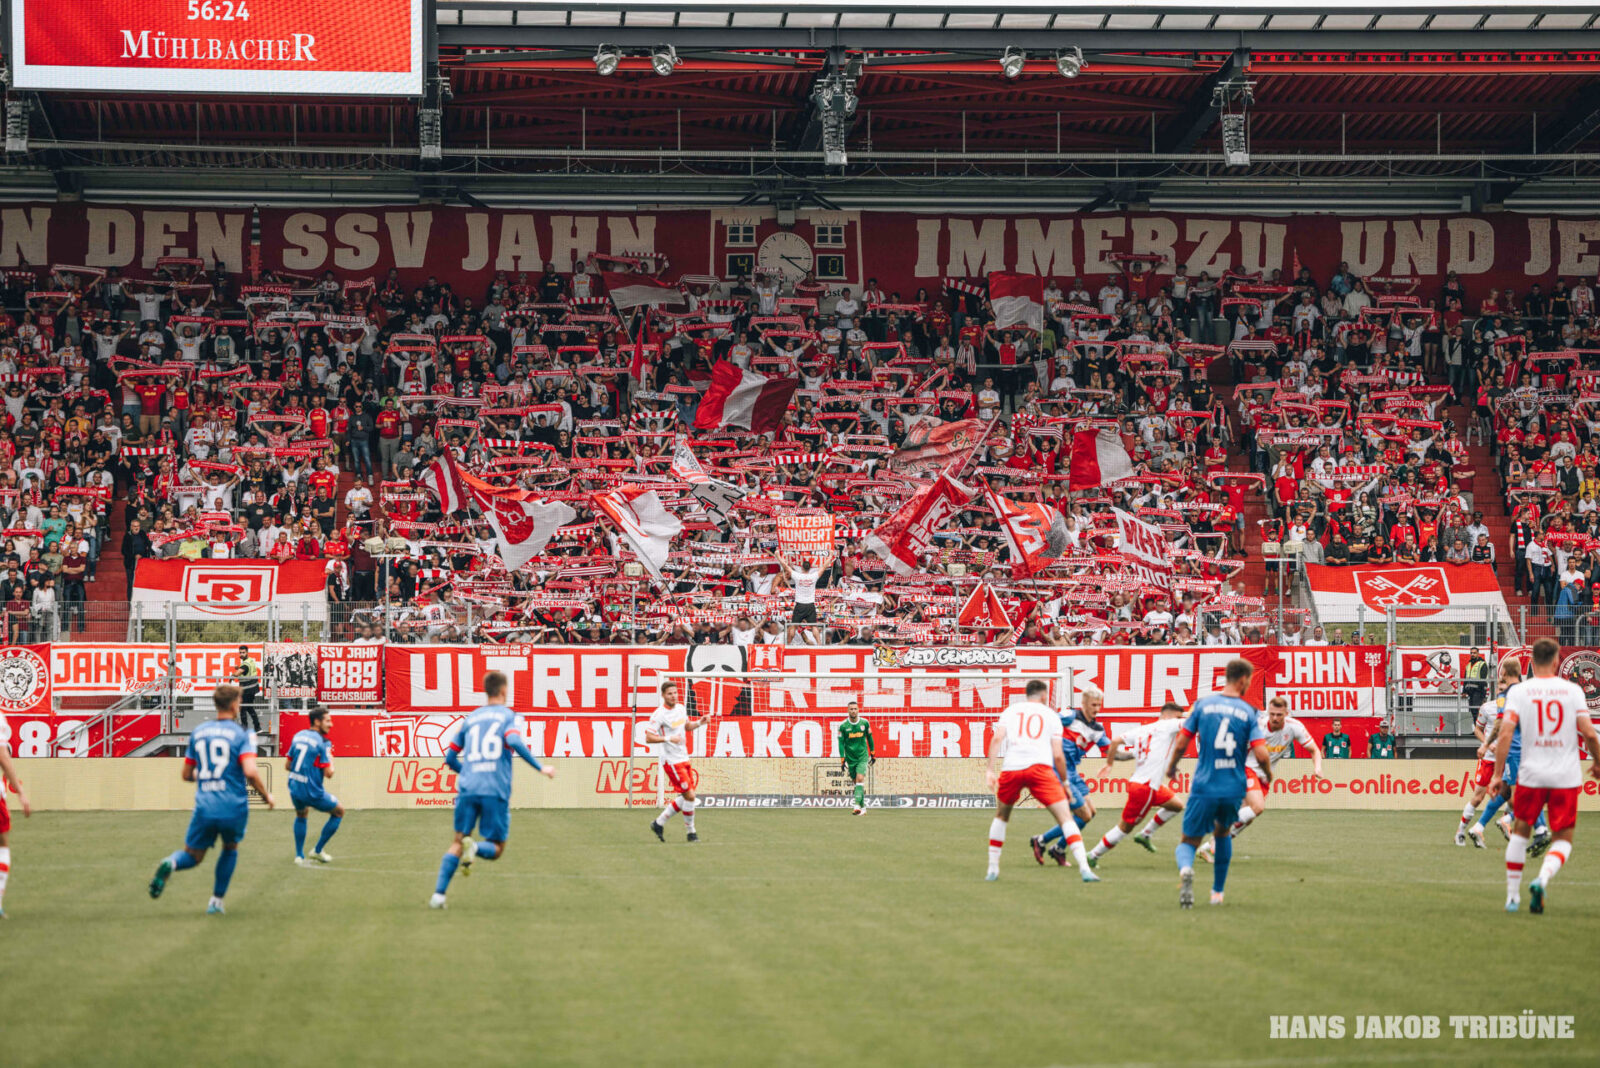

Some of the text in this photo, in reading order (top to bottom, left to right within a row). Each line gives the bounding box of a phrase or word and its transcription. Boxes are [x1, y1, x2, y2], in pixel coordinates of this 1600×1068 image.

[187, 0, 249, 21] 56:24
[120, 29, 317, 62] MÜHLBACHER
[86, 209, 245, 273] DEN
[283, 211, 433, 271] SSV
[462, 212, 657, 275] JAHN
[915, 217, 1286, 279] IMMERZU
[1341, 217, 1495, 276] UND
[777, 515, 834, 527] ACHTZEHN
[779, 528, 832, 541] HUNDERT
[321, 646, 343, 658] SSV
[346, 646, 378, 658] JAHN
[902, 648, 936, 667] RED
[321, 660, 377, 689] 1889
[410, 653, 669, 708] ULTRAS
[1276, 651, 1356, 684] JAHN
[321, 691, 378, 701] REGENSBURG
[1016, 711, 1044, 740] 10
[1532, 699, 1564, 737] 19
[467, 721, 502, 763] 16
[1214, 717, 1237, 757] 4
[195, 738, 230, 780] 19
[295, 743, 308, 773] 7
[705, 796, 778, 808] Dallmeier
[917, 796, 990, 808] Dallmeier
